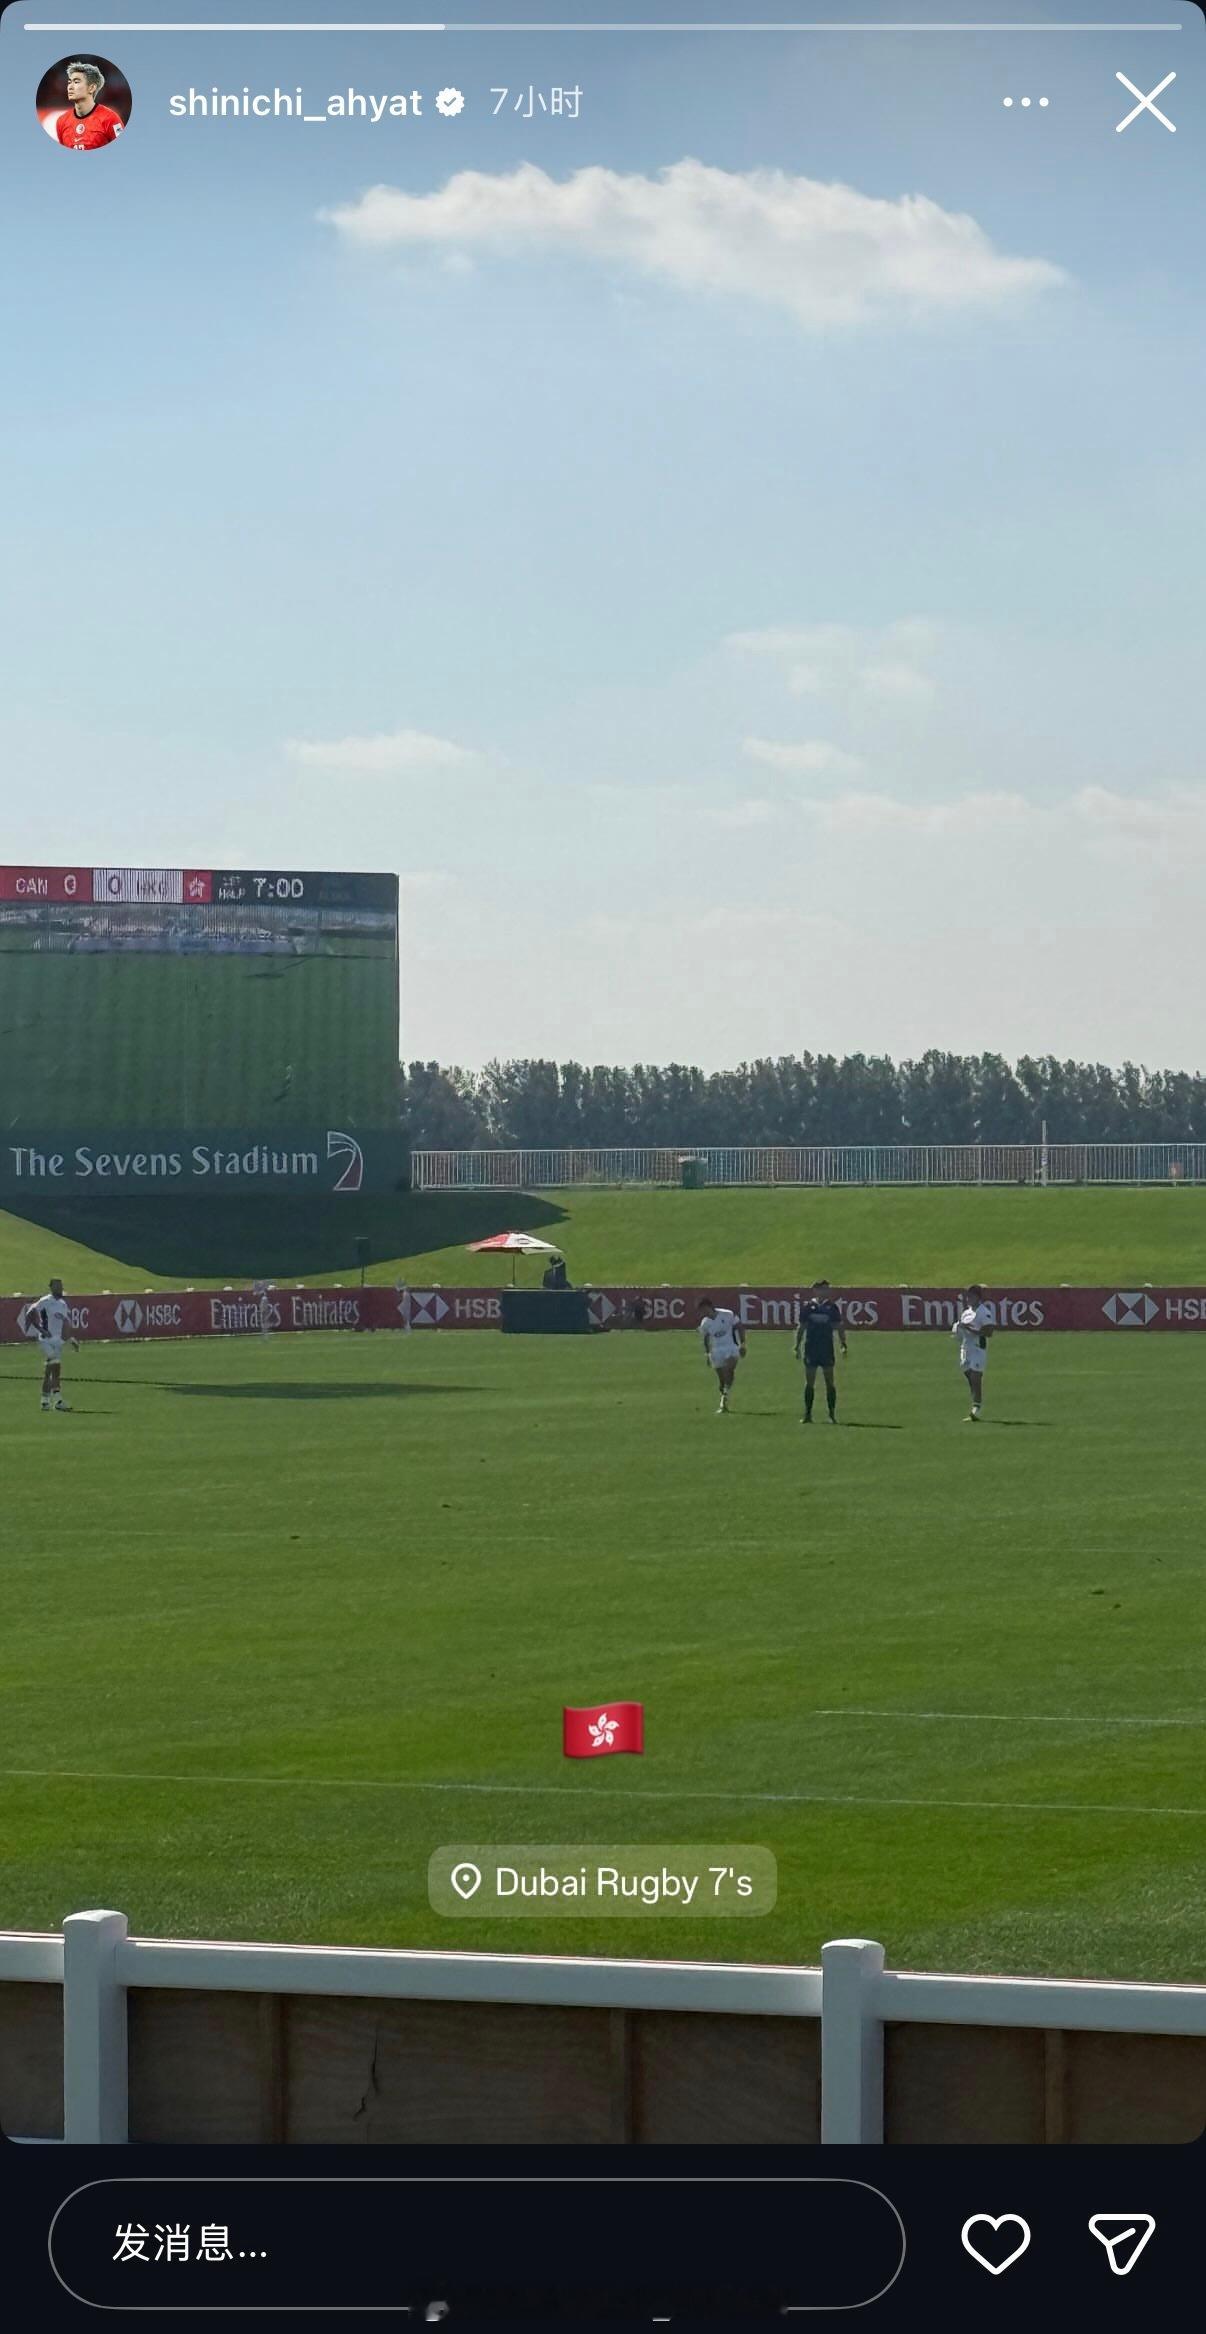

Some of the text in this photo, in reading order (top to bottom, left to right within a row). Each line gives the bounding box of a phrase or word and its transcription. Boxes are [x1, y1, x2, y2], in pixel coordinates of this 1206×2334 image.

[16, 878, 48, 895] CAN
[252, 878, 304, 898] 7:00
[8, 1147, 65, 1177] The
[75, 1146, 183, 1177] Sevens
[191, 1145, 319, 1175] Stadium
[145, 1304, 182, 1327] HSBC
[291, 1294, 361, 1327] Emirates
[455, 1299, 501, 1319] HSB
[739, 1293, 879, 1325] Emites
